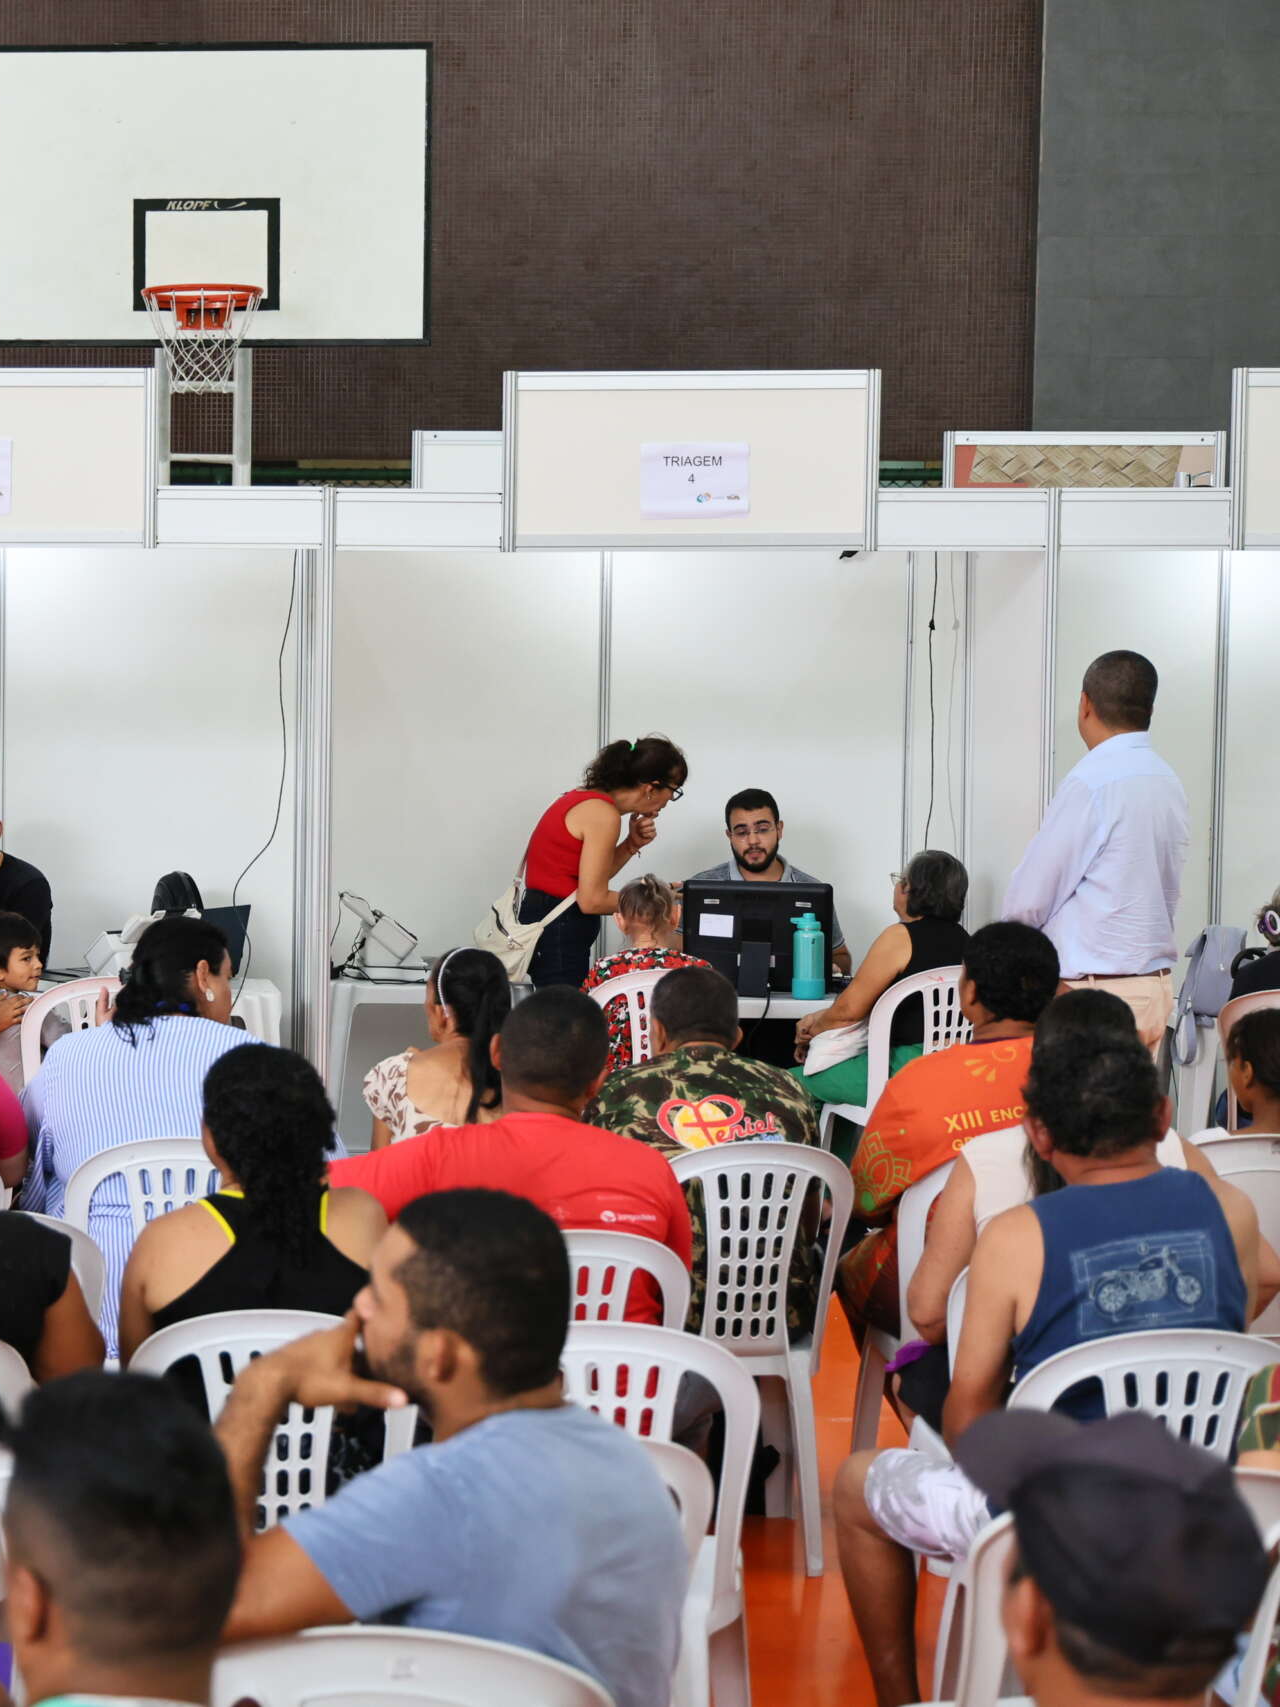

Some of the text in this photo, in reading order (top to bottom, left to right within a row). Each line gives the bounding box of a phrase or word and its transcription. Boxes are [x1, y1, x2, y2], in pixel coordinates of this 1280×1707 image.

[166, 200, 212, 211] KLOPF
[663, 455, 723, 467] TRIAGEM
[687, 473, 696, 484] 4
[943, 1105, 1025, 1134] XIII ENC
